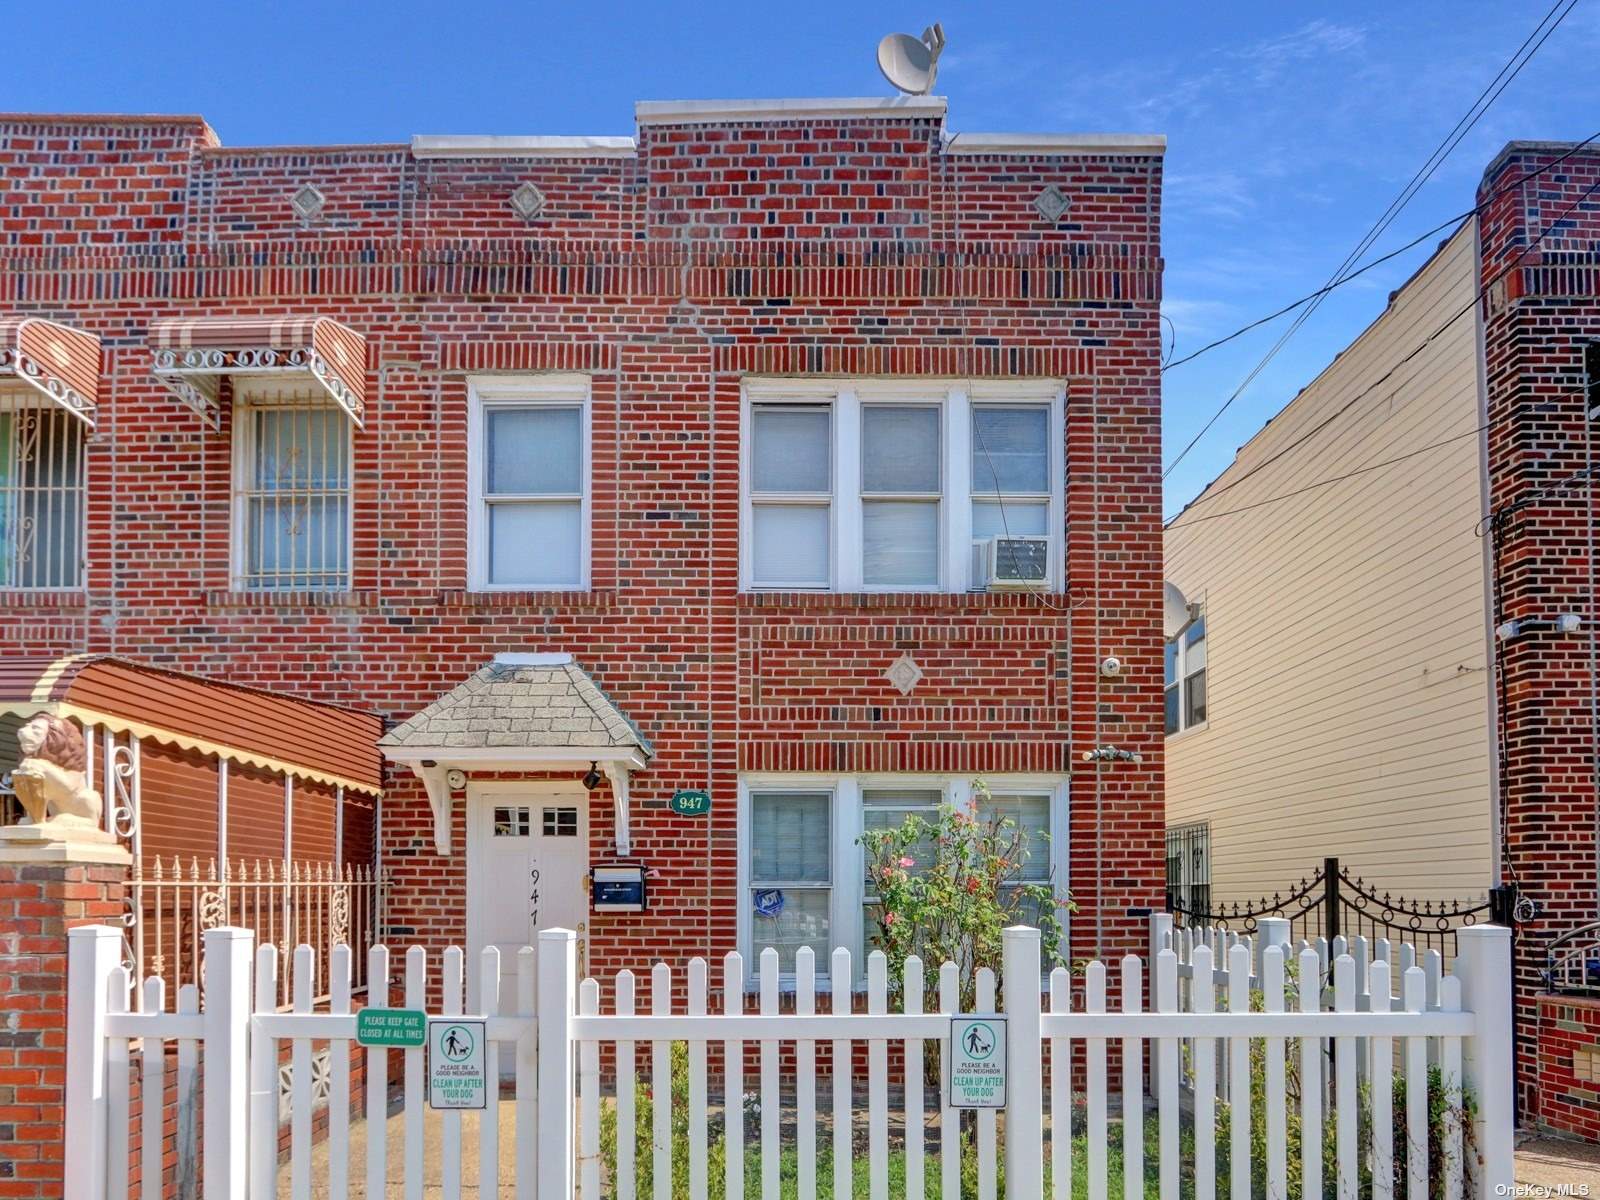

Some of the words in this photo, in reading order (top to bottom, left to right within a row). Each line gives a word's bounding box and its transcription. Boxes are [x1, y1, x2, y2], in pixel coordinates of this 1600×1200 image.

[680, 797, 702, 809] 947
[530, 869, 540, 926] 947
[761, 892, 779, 909] ADT
[364, 1016, 386, 1026] PLEASE
[388, 1017, 402, 1026] KEEP
[404, 1017, 419, 1027] GATE
[360, 1029, 382, 1038] CLOSED
[384, 1029, 391, 1038] AT
[393, 1029, 403, 1039] ALL
[405, 1030, 423, 1039] TIMES
[432, 1078, 453, 1089] CLEAN
[453, 1079, 462, 1089] UP
[463, 1078, 483, 1089] AFTER
[953, 1077, 973, 1086] CLEAN
[975, 1077, 983, 1086] UP
[984, 1077, 1003, 1087] AFTER
[442, 1089, 459, 1099] YOUR
[460, 1089, 474, 1099] DOG
[962, 1087, 979, 1096] YOUR
[980, 1087, 994, 1096] DOG
